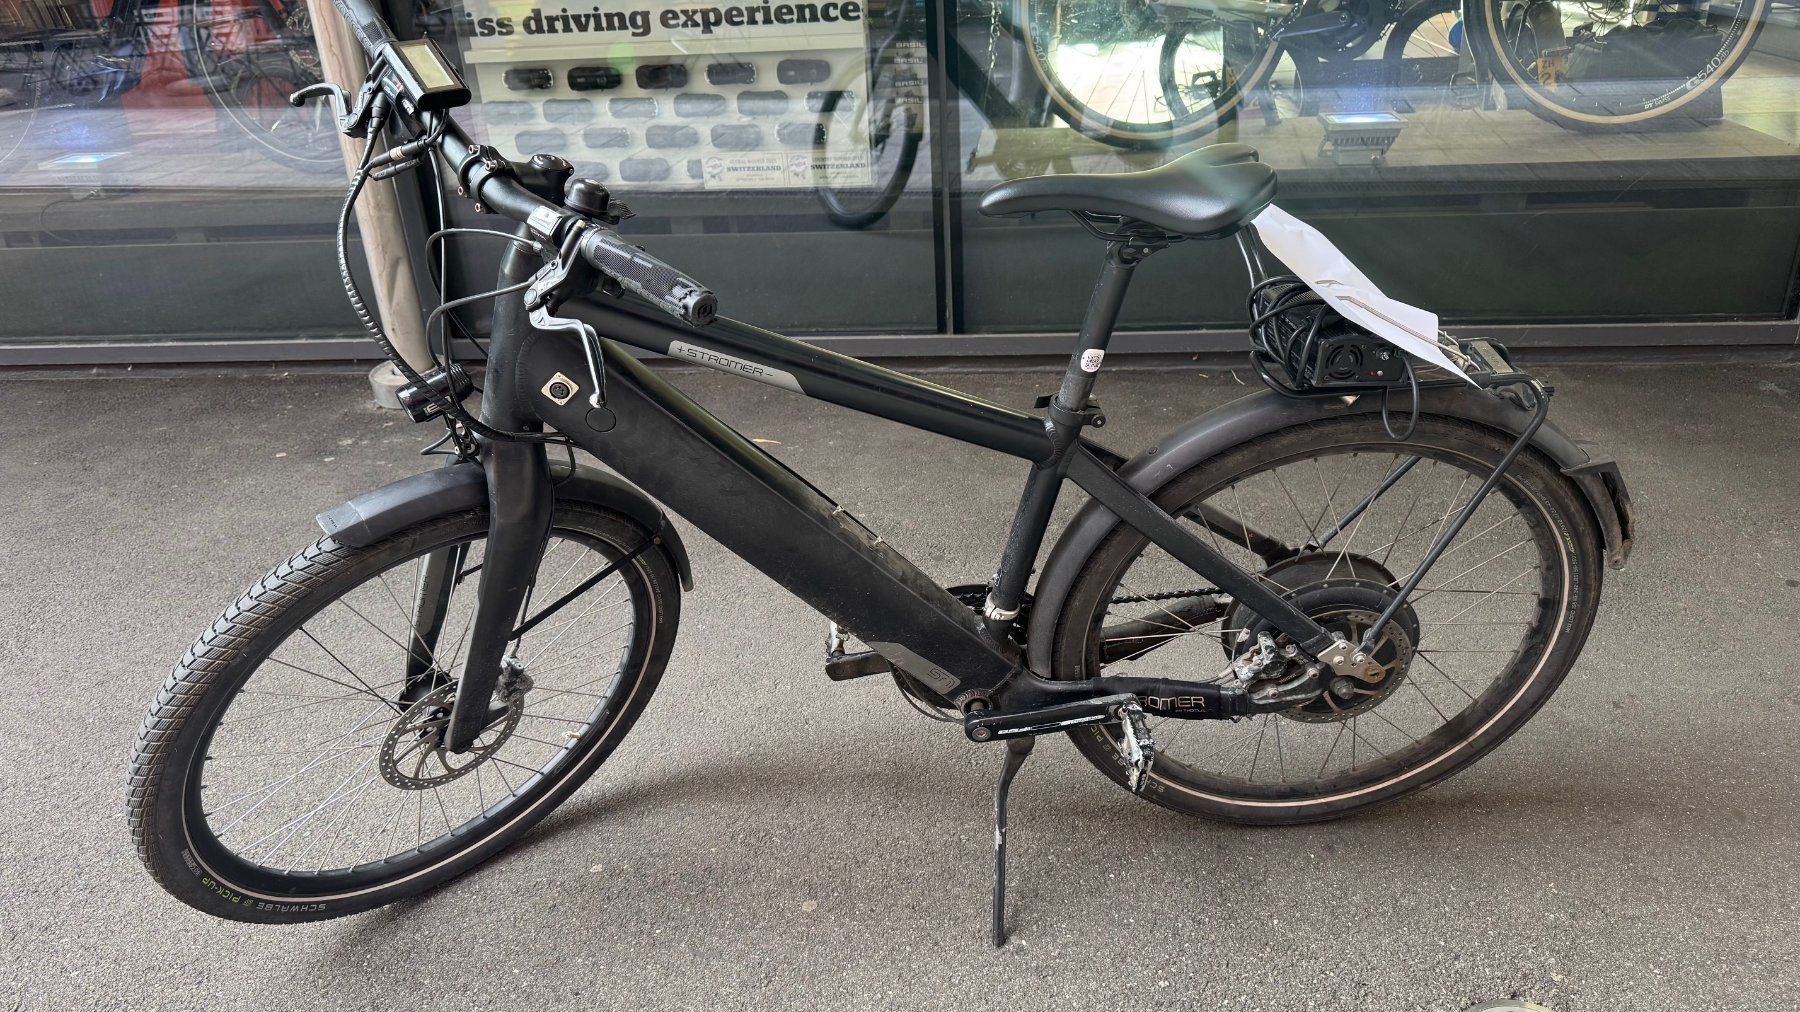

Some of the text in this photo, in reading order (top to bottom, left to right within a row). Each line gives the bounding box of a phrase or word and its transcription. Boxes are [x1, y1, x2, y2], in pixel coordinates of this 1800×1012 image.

[523, 6, 651, 37] driving
[659, 0, 861, 34] experience
[727, 164, 782, 172] SWITZERLAND
[811, 162, 867, 170] SWITZERLAND
[201, 876, 326, 912] SCHWALBE PICK-UP
